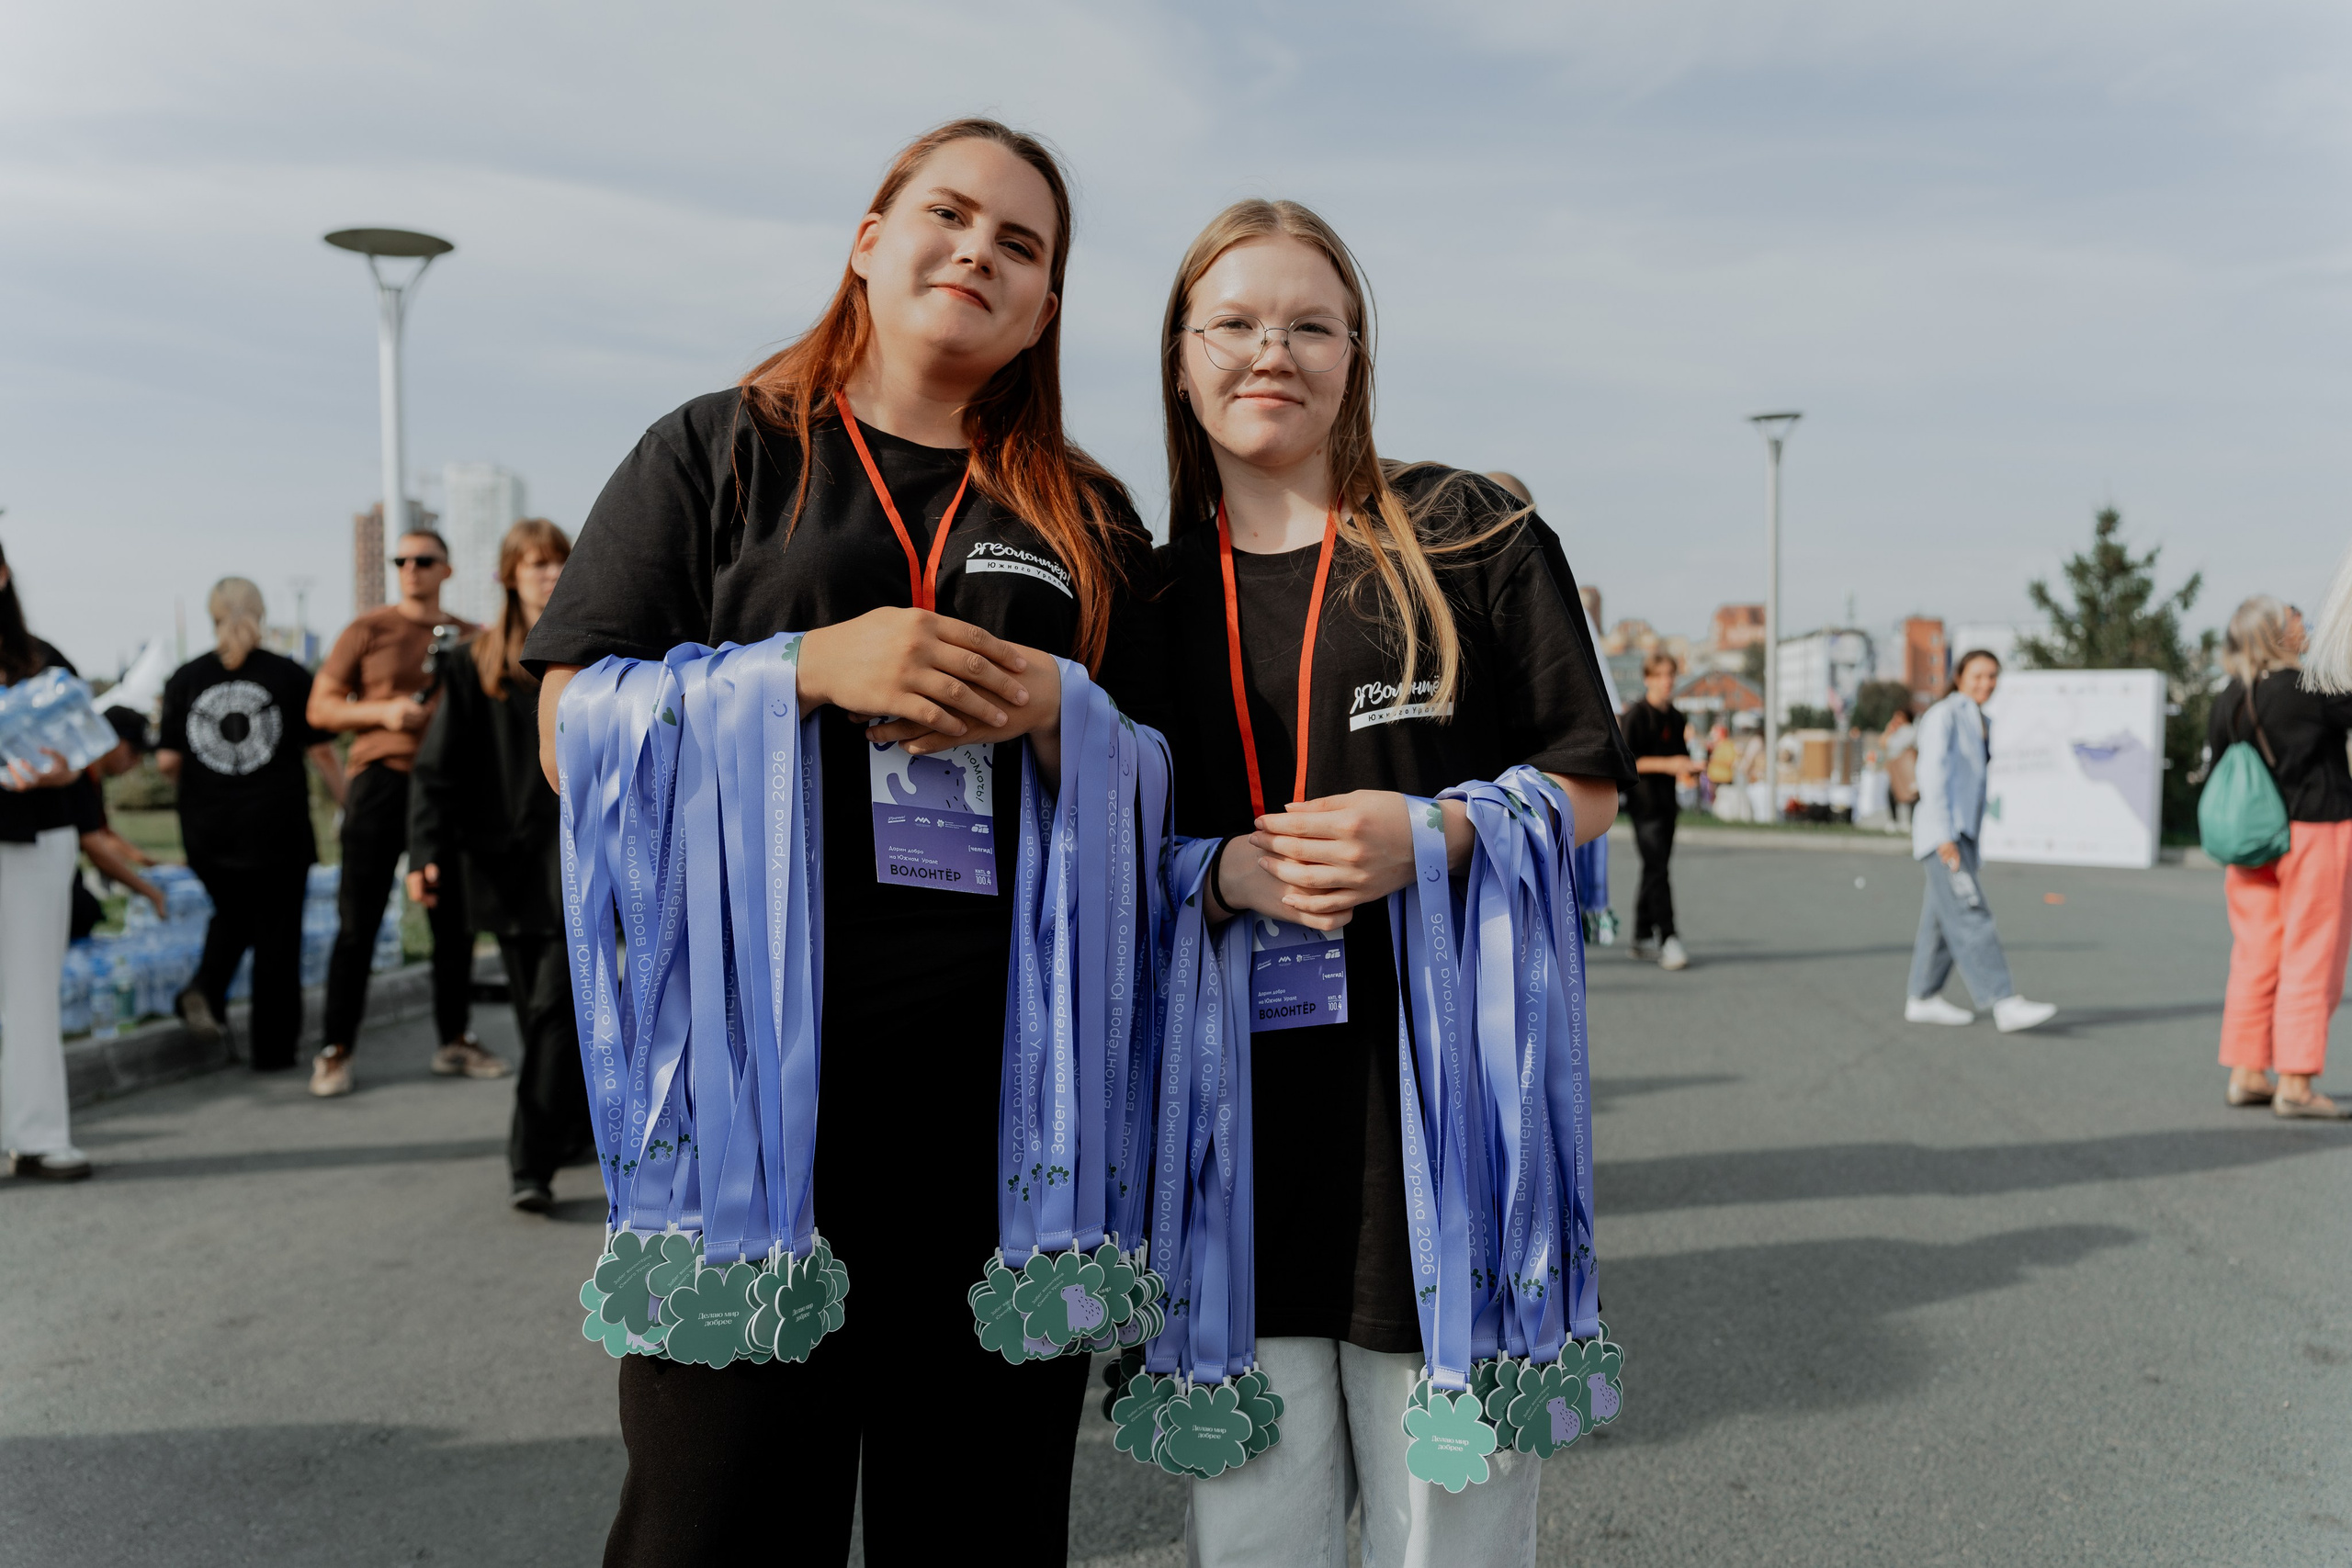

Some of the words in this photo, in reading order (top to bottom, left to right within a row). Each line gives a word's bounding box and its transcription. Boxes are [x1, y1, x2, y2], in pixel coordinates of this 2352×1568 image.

[772, 750, 786, 802] 2026
[772, 809, 786, 871] Урала
[1108, 789, 1118, 838] 2026
[1122, 807, 1130, 855] 2026
[627, 835, 647, 947] волонтёров
[890, 863, 961, 882] ВОЛОНТЁР
[1023, 836, 1035, 946] волонтёров
[1117, 861, 1131, 919] Урала
[566, 829, 584, 938] волонтёров
[575, 944, 595, 1021] Южного
[773, 878, 782, 960] Южного
[1056, 898, 1066, 976] Южного
[1430, 913, 1448, 962] 2026
[646, 948, 673, 1025] Южного
[1111, 925, 1128, 1000] Южного
[1178, 936, 1193, 987] Забег
[1206, 952, 1218, 997] 2026
[1525, 948, 1542, 1004] Урала
[1567, 932, 1579, 987] Урала
[1025, 953, 1038, 1032] Южного
[1259, 1001, 1317, 1020] ВОЛОНТЁР
[1441, 967, 1455, 1027] Урала
[1055, 984, 1067, 1093] волонтёров
[1104, 1006, 1123, 1109] волонтёров
[1167, 994, 1185, 1095] волонтёров
[1201, 1003, 1217, 1056] Урала
[1520, 1011, 1538, 1089] Южного
[1571, 992, 1581, 1066] Южного
[598, 1032, 616, 1089] Урала
[635, 1031, 652, 1090] Урала
[1027, 1038, 1042, 1098] Урала
[1448, 1032, 1462, 1110] Южного
[606, 1096, 622, 1144] 2026
[630, 1099, 647, 1148] 2026
[1028, 1102, 1042, 1152] 2026
[1195, 1063, 1213, 1134] Южного
[1404, 1078, 1417, 1156] Южного
[1051, 1100, 1066, 1155] Забег
[1164, 1101, 1181, 1173] Южного
[1217, 1103, 1231, 1177] Южного
[1159, 1179, 1176, 1232] Урала
[1408, 1162, 1426, 1220] Урала
[1158, 1238, 1172, 1282] 2026
[1417, 1226, 1435, 1275] 2026
[1511, 1207, 1525, 1261] Забег
[1529, 1218, 1543, 1268] 2026
[698, 1312, 724, 1320] Делаю
[704, 1318, 733, 1327] добрее
[1431, 1435, 1454, 1443] Делаю
[1454, 1438, 1470, 1446] мир
[1438, 1443, 1464, 1452] добрее
